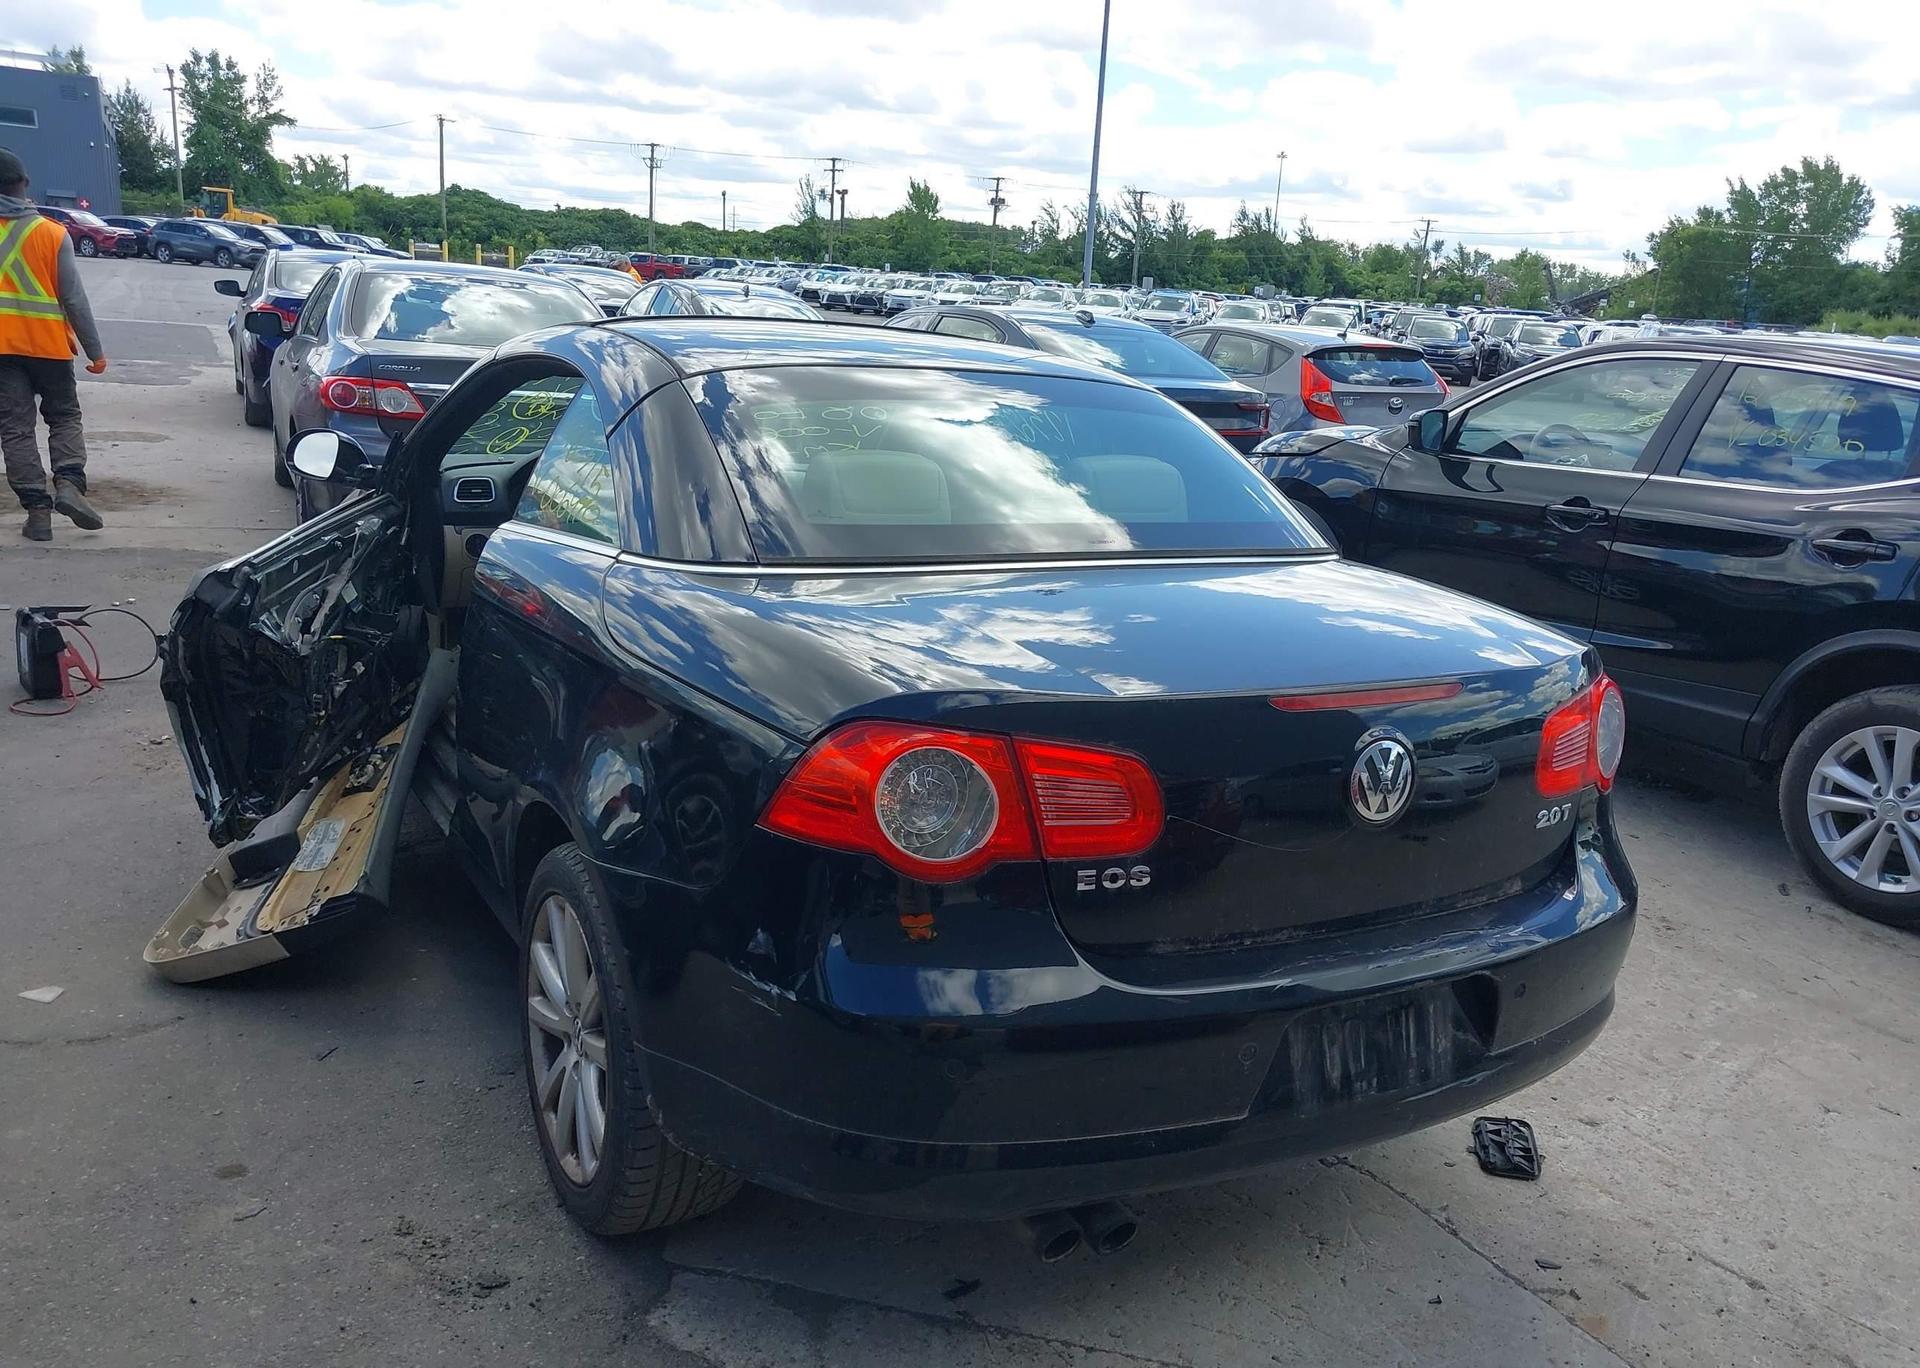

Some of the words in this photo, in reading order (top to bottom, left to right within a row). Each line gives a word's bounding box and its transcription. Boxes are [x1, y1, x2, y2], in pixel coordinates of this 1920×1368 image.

[908, 767, 944, 794] RR
[1350, 740, 1412, 821] VW
[1077, 865, 1151, 890] EOS
